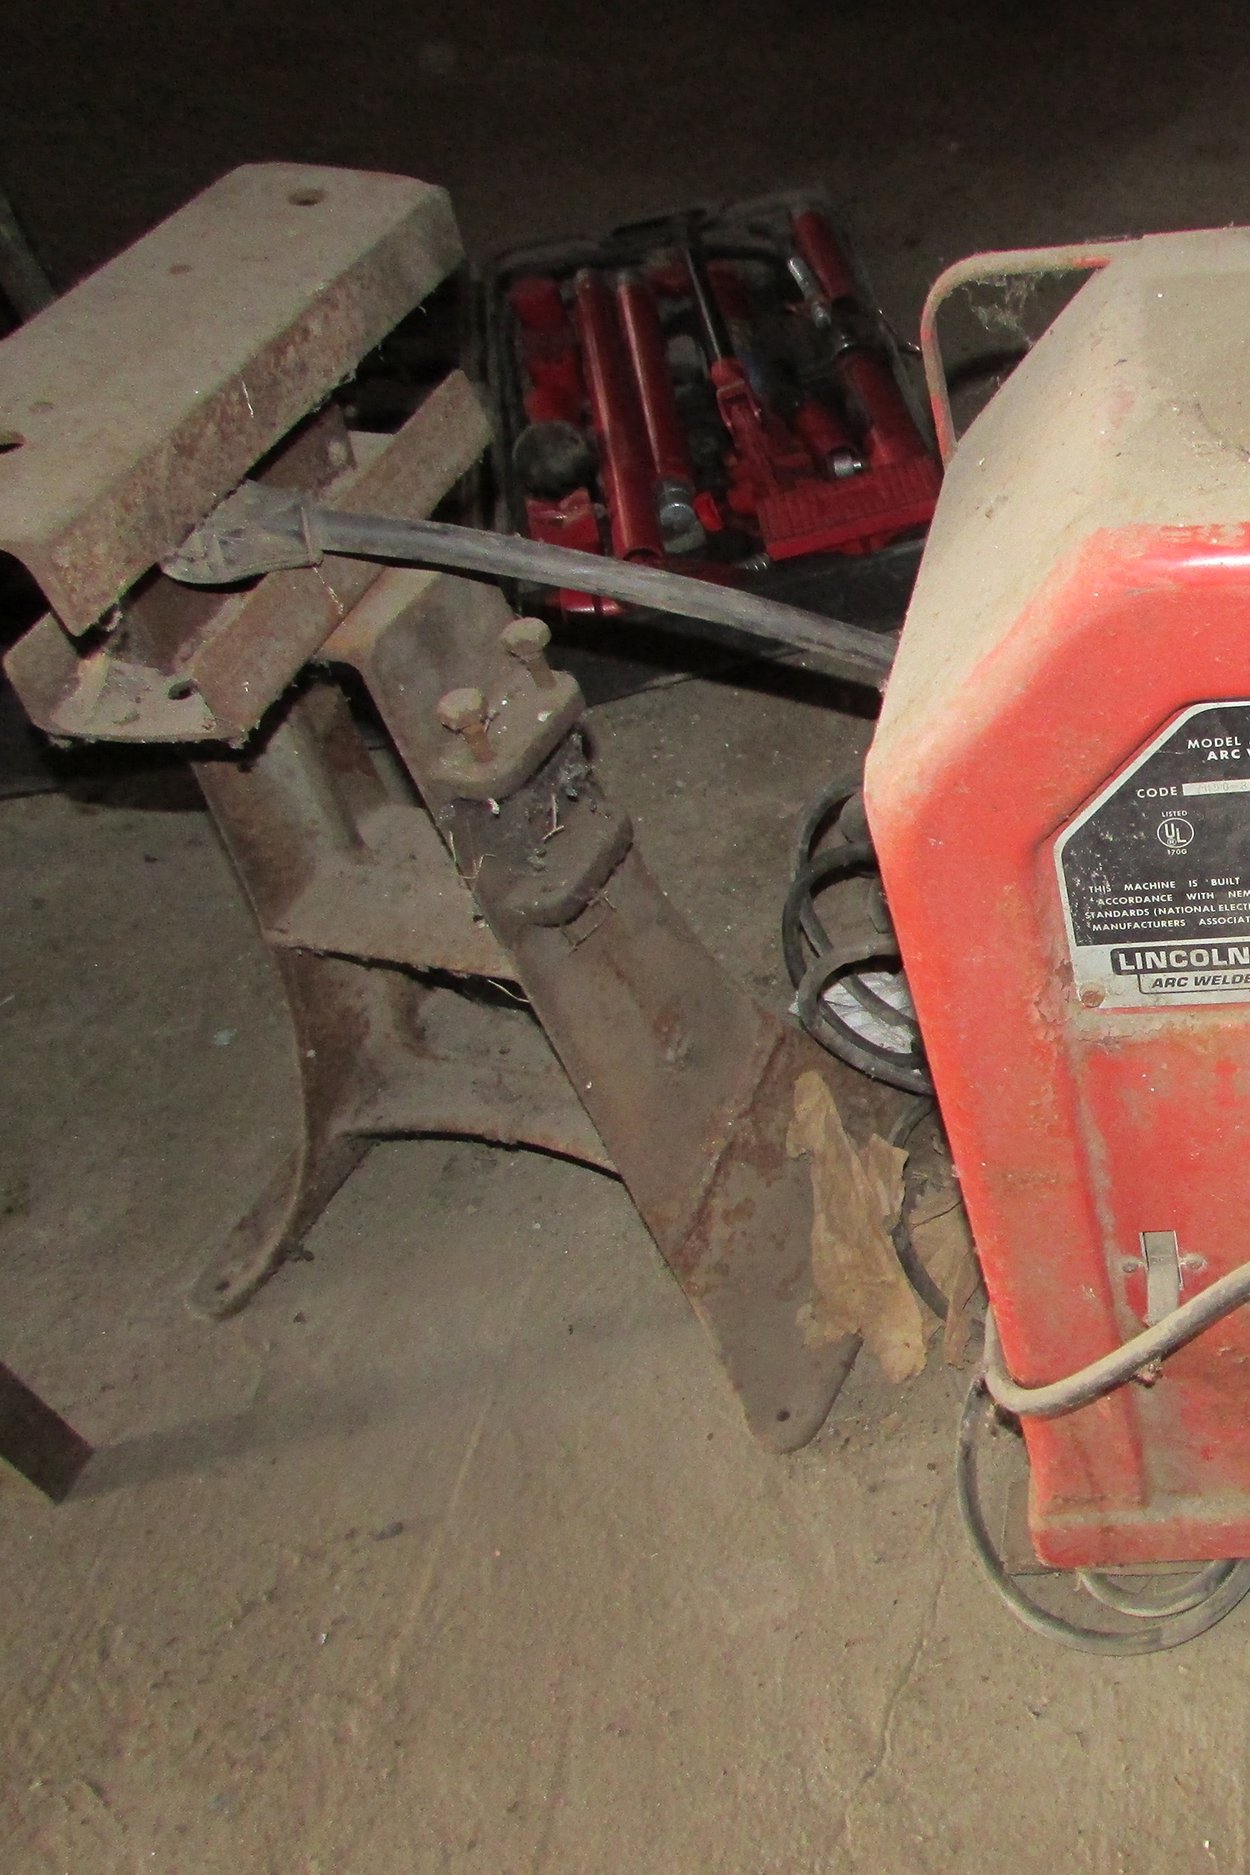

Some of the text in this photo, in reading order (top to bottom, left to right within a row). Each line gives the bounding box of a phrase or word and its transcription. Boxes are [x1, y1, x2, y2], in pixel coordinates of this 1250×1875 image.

[1188, 737, 1241, 749] MODEL
[1207, 751, 1240, 761] ARC
[1136, 787, 1178, 798] CODE
[1089, 885, 1111, 894] THIS
[1124, 881, 1176, 891] MACHINE
[1210, 877, 1240, 886] BUILT
[1097, 894, 1173, 906] ACCORDANCE
[1186, 892, 1214, 900] WITH
[1085, 909, 1150, 919] STANDARDS
[1154, 904, 1216, 916] (NATIONAL
[1092, 919, 1186, 931] MANUFACTURERS
[1119, 947, 1250, 971] LINCOLN
[1152, 976, 1189, 988] ARC
